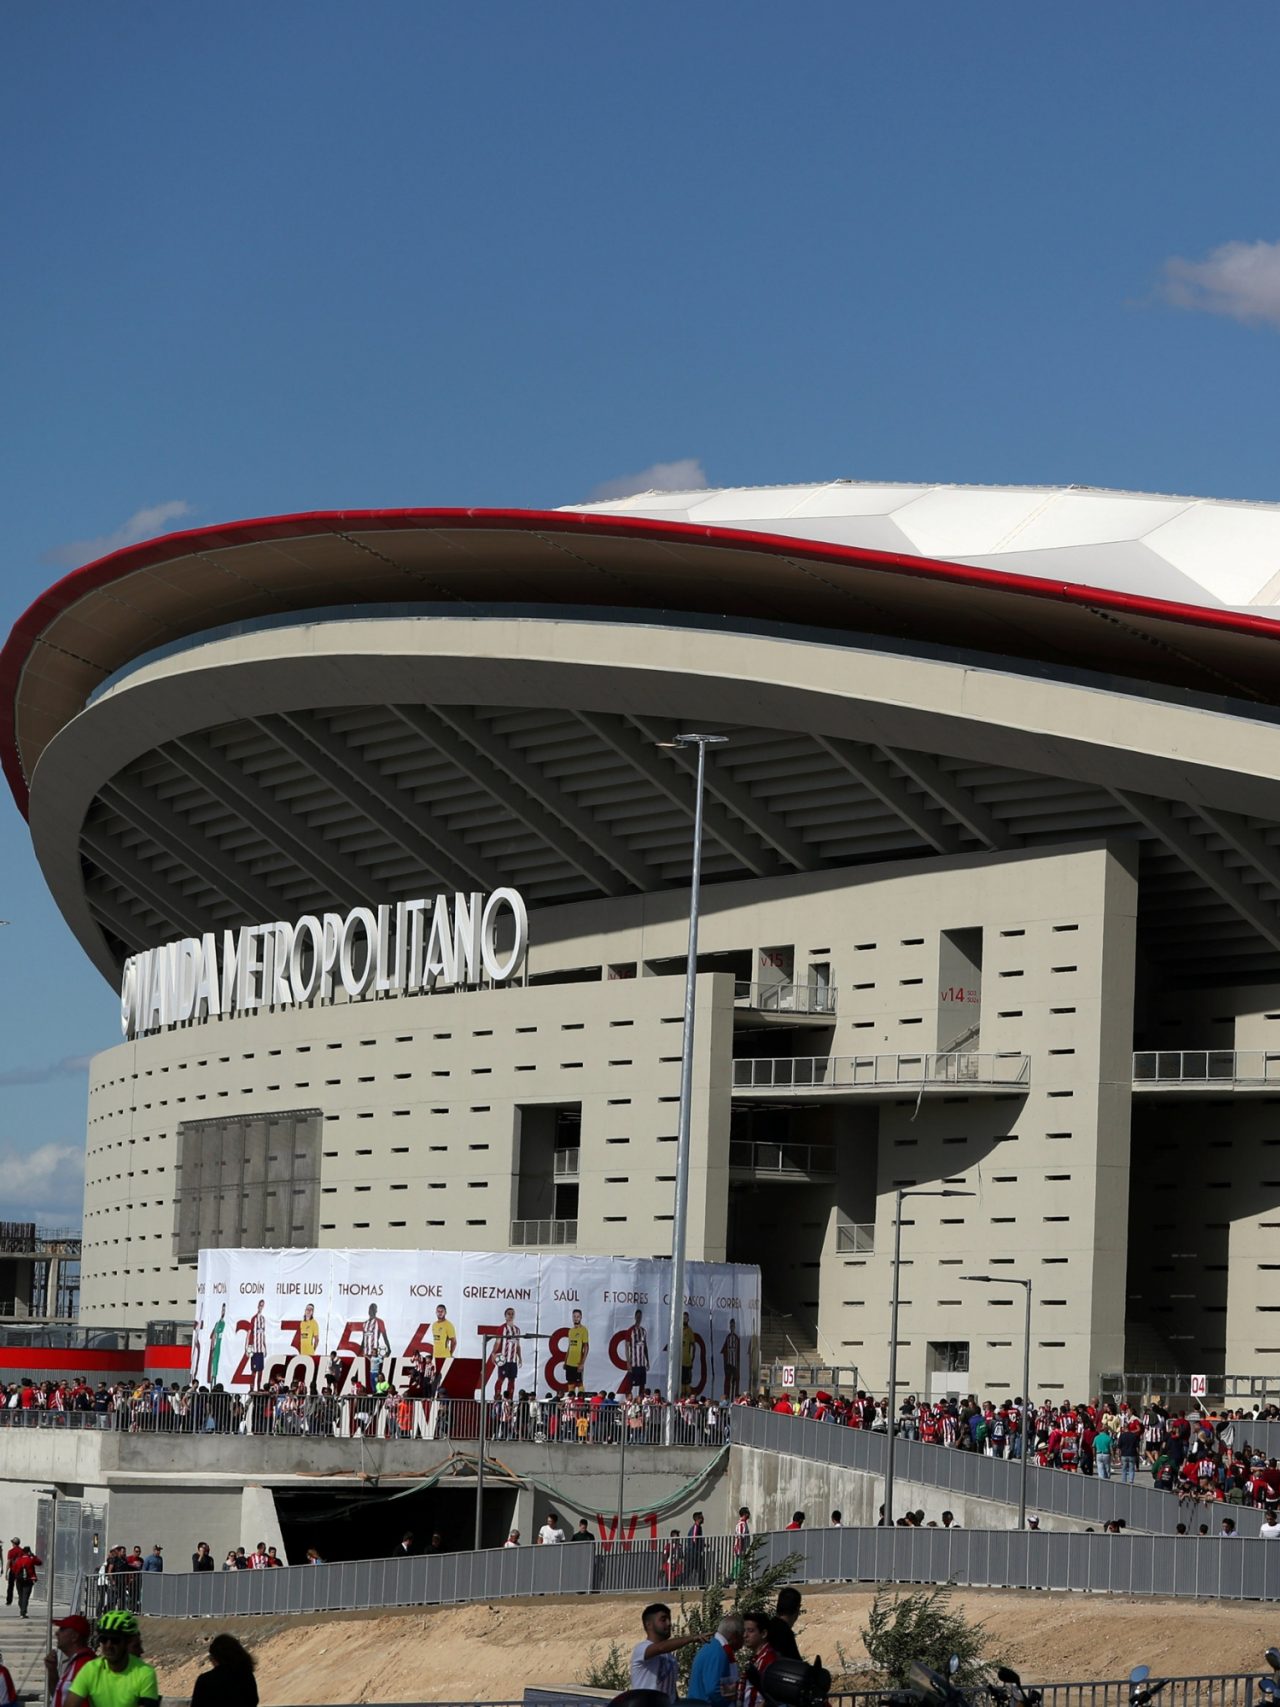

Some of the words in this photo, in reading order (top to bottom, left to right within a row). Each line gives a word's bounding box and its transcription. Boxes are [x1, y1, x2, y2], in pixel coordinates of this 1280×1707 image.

[221, 887, 528, 1014] METROPOLITANO
[941, 987, 965, 1003] v14
[239, 1280, 265, 1295] GODÍN
[276, 1283, 301, 1295] FILIPE
[304, 1283, 323, 1295] LUIS
[338, 1283, 384, 1296] THOMAS
[410, 1284, 443, 1297] KOKE
[463, 1286, 531, 1300] GRIEZMANN
[554, 1287, 580, 1302] SAÚL
[663, 1294, 705, 1308] CRASCO
[783, 1368, 794, 1384] 05
[1192, 1377, 1205, 1394] 04
[596, 1513, 657, 1553] W1
